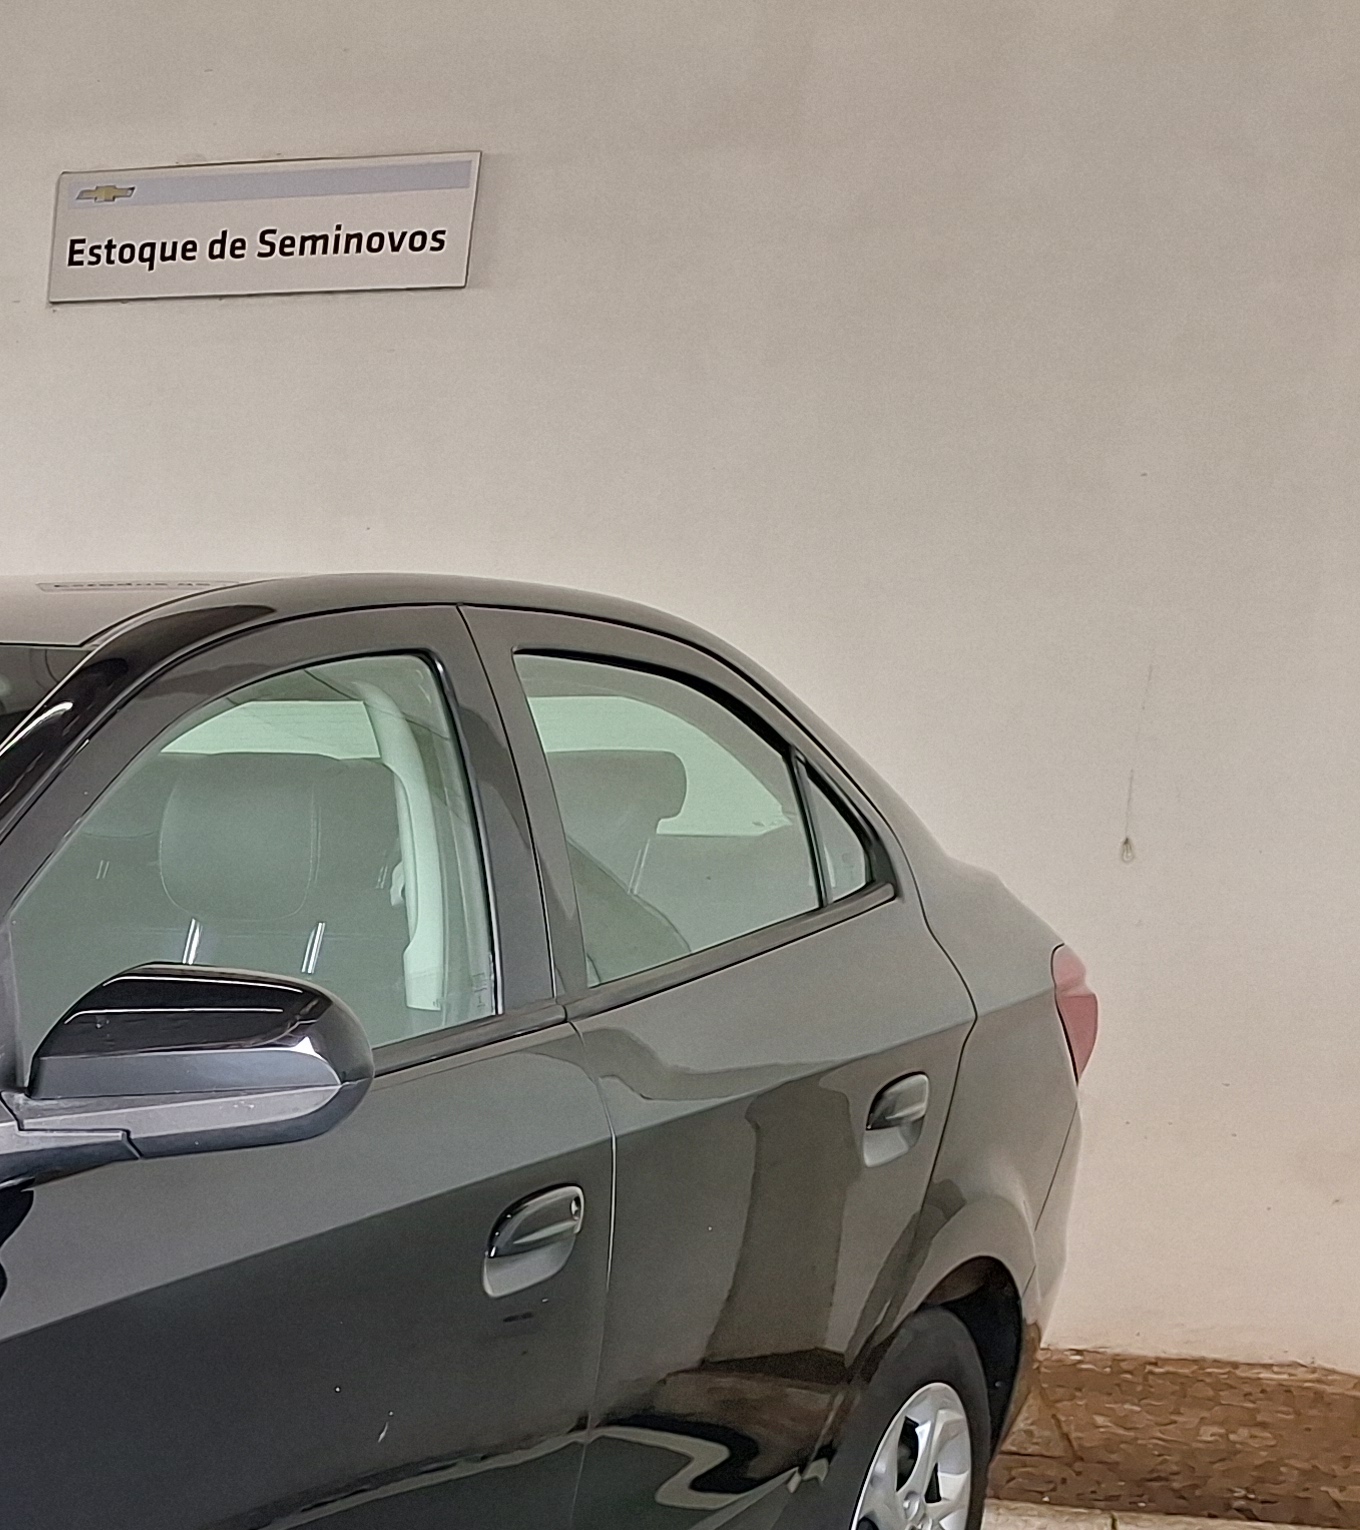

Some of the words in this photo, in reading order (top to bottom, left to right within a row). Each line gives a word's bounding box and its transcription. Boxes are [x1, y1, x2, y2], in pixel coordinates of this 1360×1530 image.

[66, 237, 199, 272] Estoque
[207, 229, 247, 261] de
[256, 224, 447, 259] Seminovos
